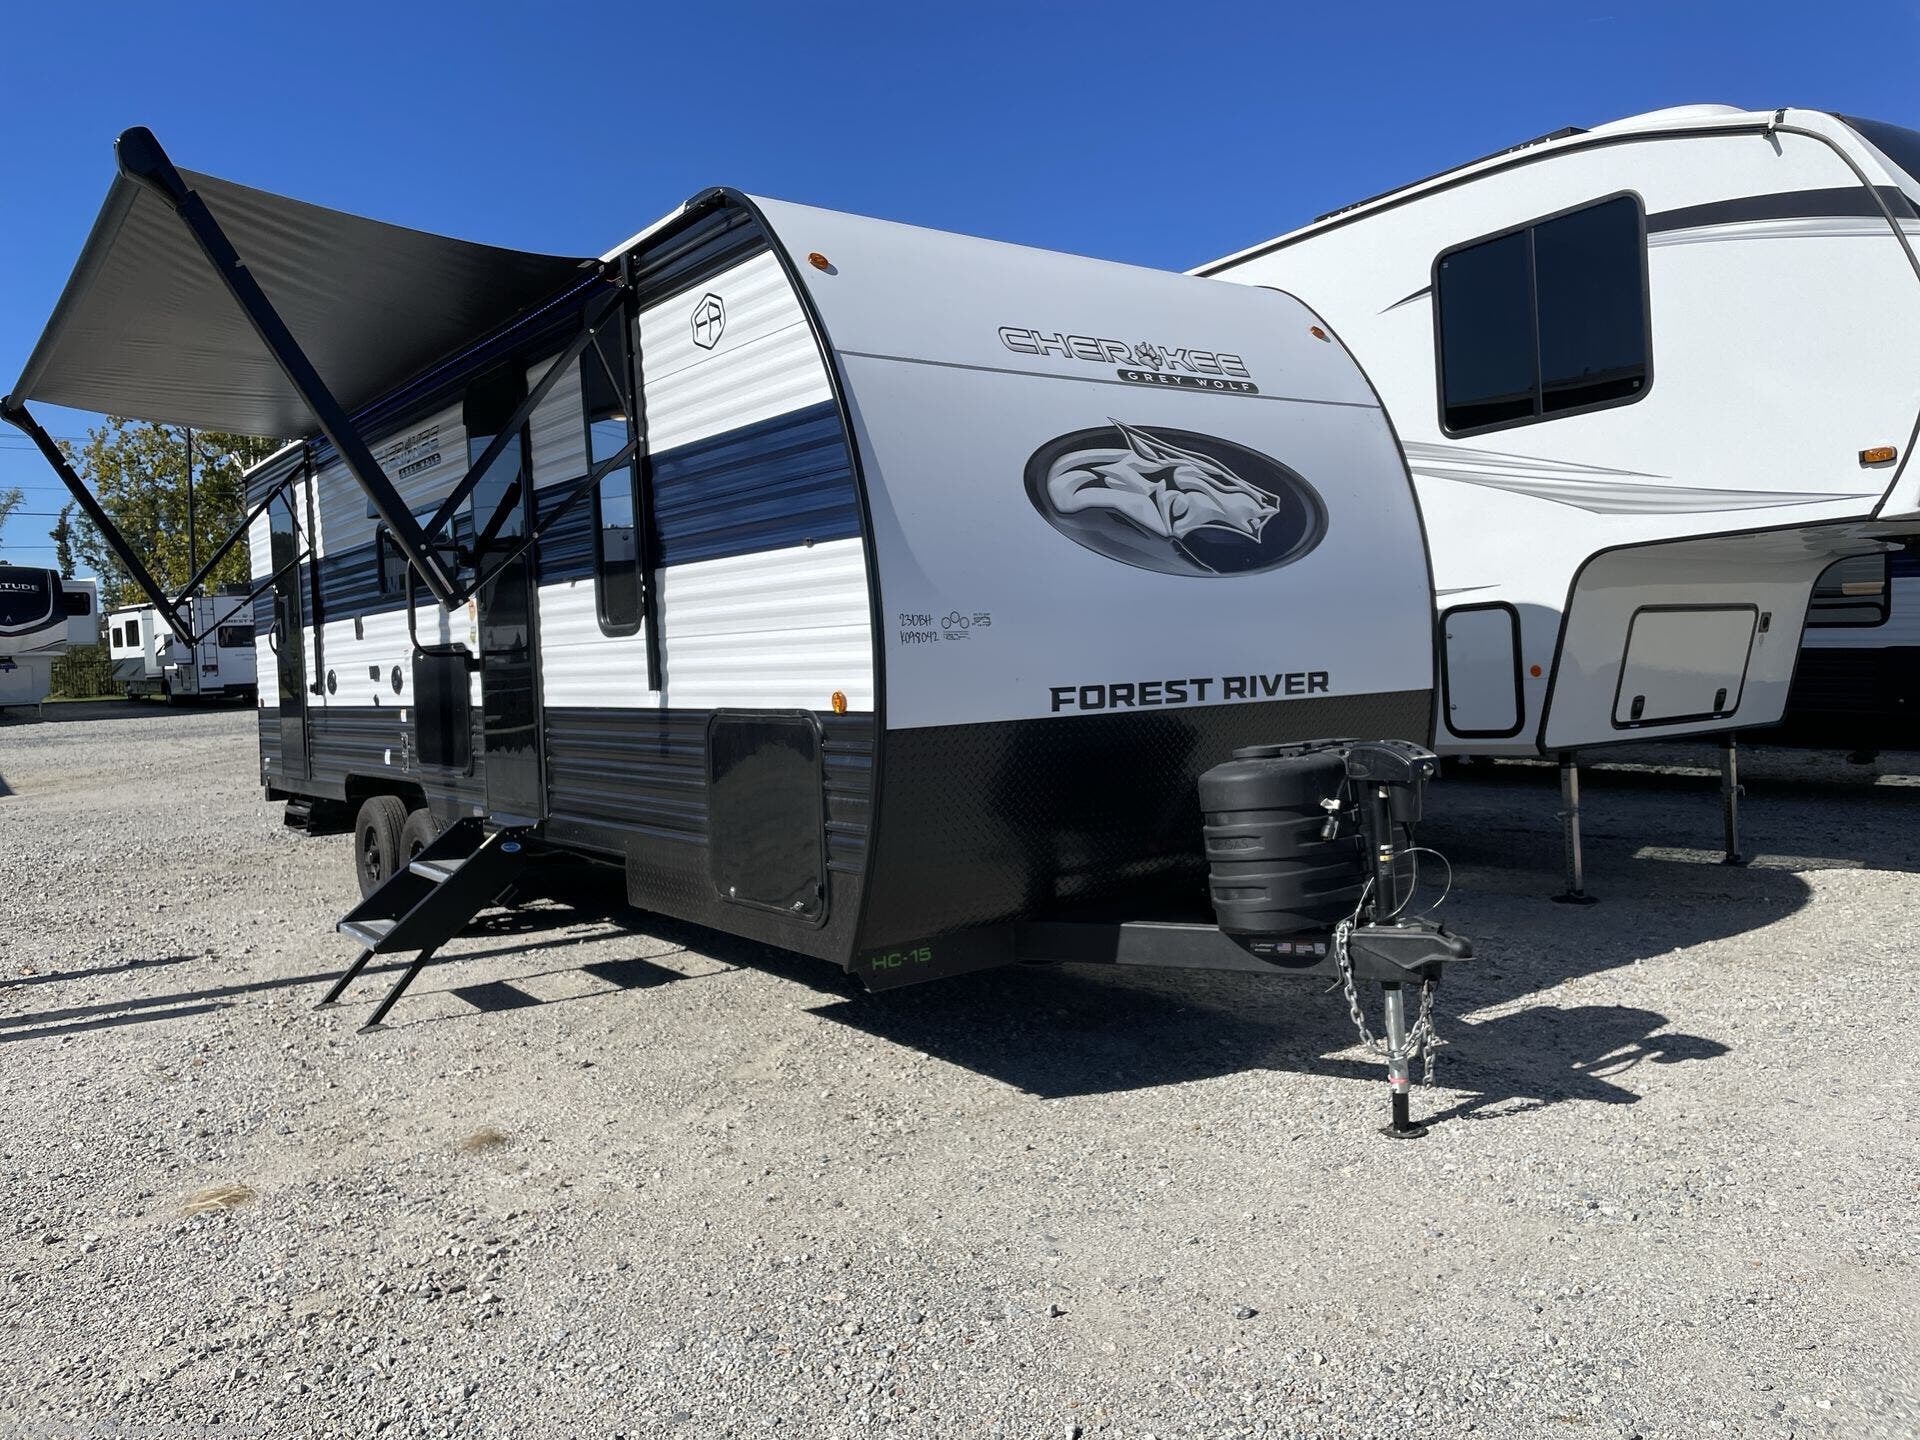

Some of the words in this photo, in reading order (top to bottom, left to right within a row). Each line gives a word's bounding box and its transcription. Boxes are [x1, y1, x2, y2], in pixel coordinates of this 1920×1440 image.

[1127, 371, 1183, 385] GREY
[1197, 378, 1250, 391] WOLF
[1049, 678, 1213, 712] FOREST
[1222, 671, 1329, 700] RIVER
[872, 947, 932, 971] HC-15
